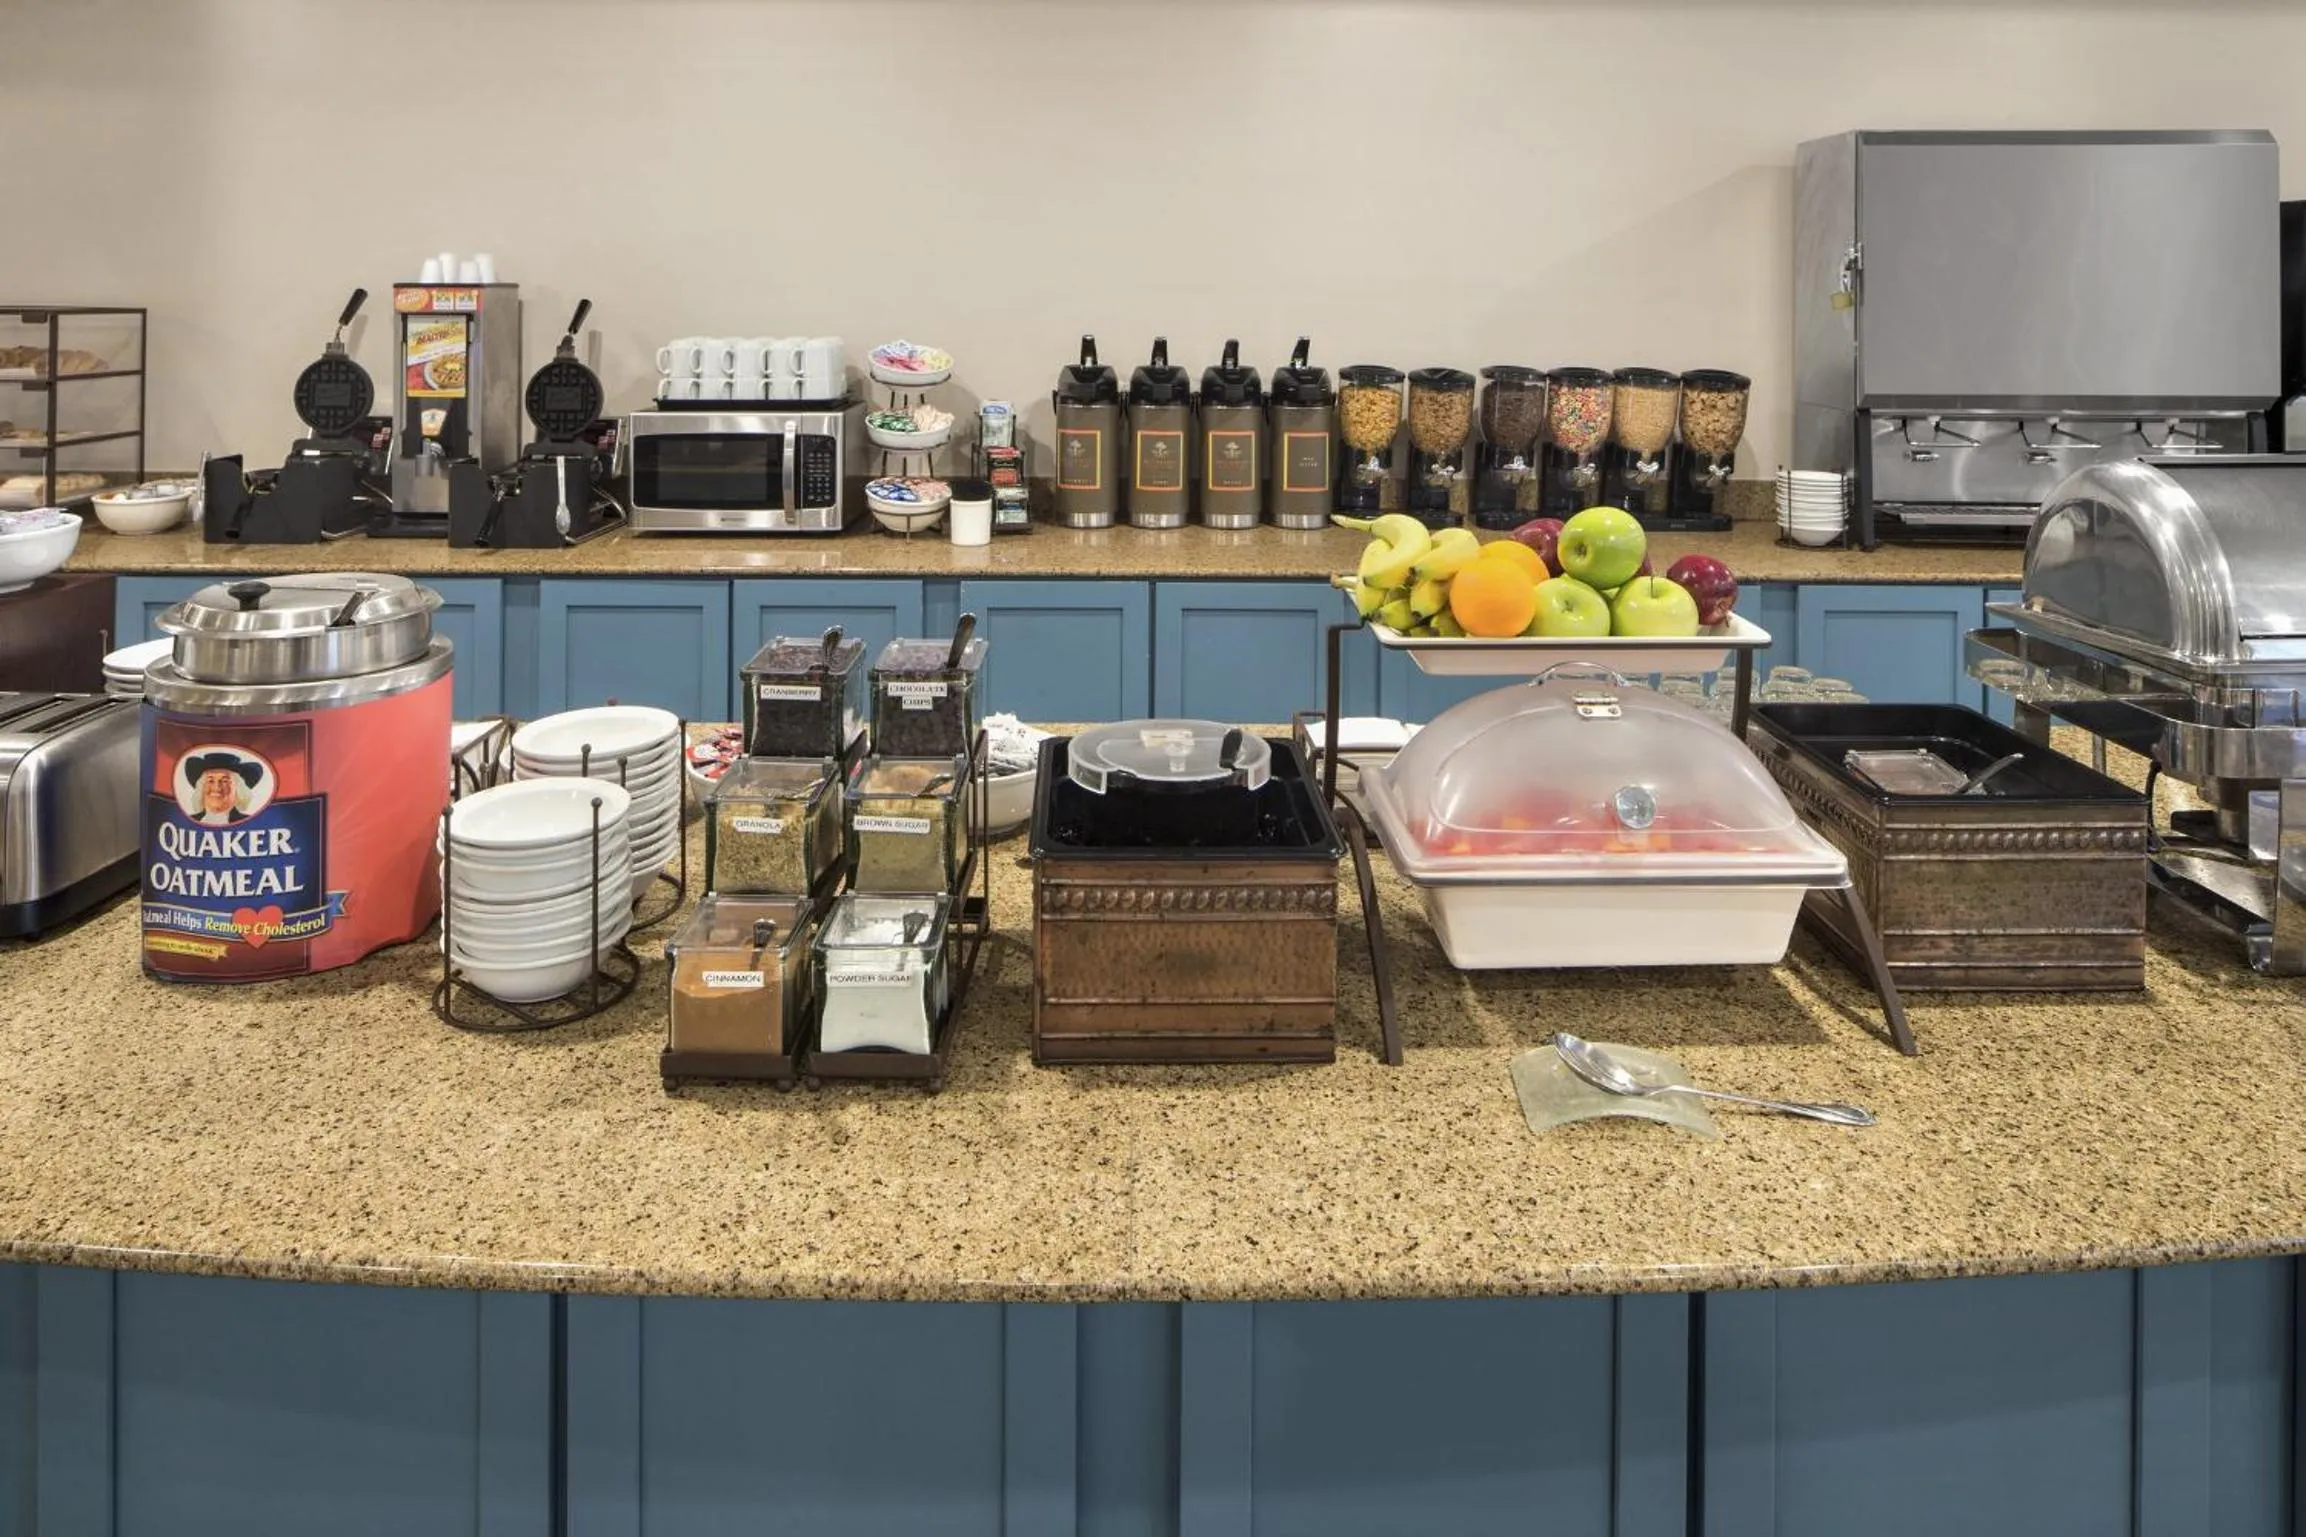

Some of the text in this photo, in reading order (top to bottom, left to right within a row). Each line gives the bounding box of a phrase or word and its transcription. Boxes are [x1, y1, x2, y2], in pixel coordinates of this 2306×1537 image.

[763, 687, 817, 698] CRANBERRY
[735, 819, 781, 830] GRANOLA
[856, 819, 928, 829] BROWN SUGAR
[159, 821, 293, 861] QUAKER
[150, 862, 304, 897] OATMEAL
[143, 909, 325, 935] atmeal Helps Remove Cholesterol
[705, 974, 761, 983] CINNAMON
